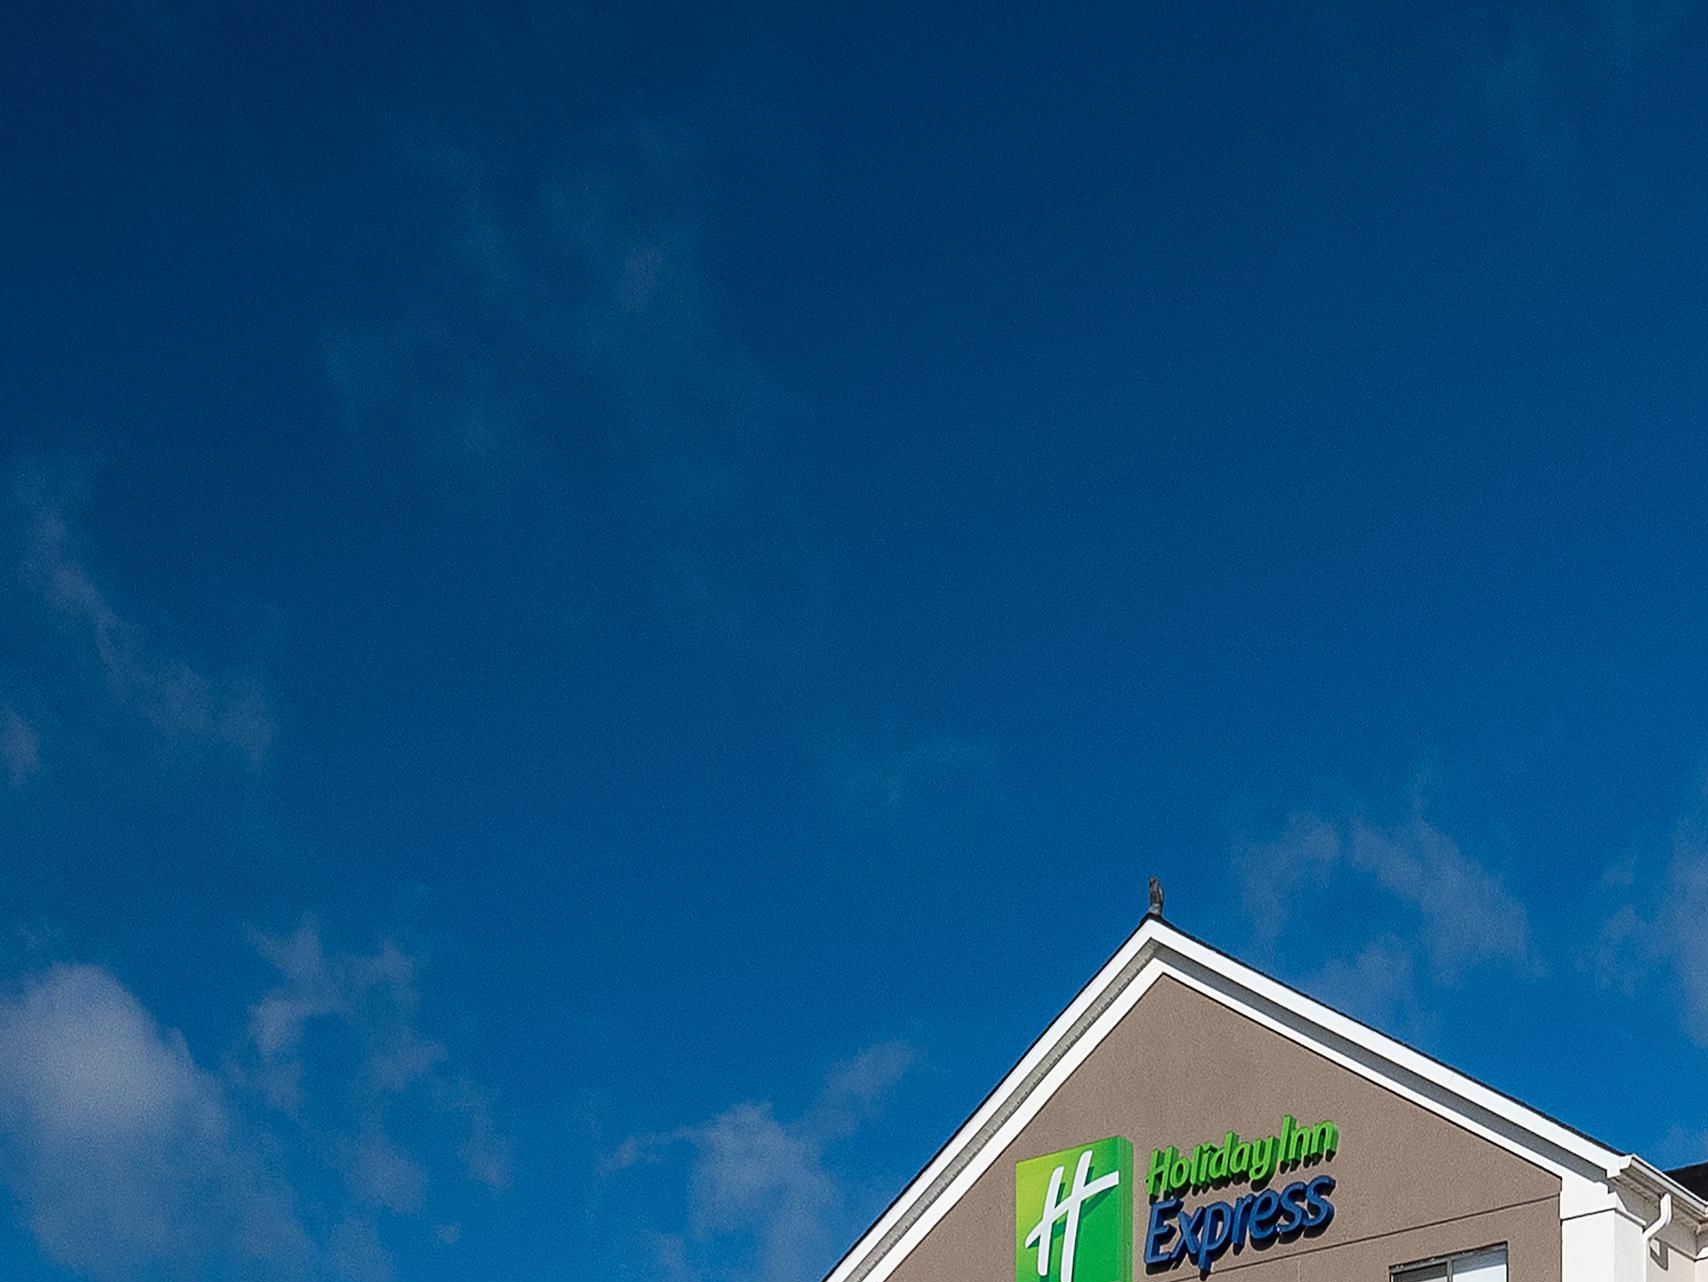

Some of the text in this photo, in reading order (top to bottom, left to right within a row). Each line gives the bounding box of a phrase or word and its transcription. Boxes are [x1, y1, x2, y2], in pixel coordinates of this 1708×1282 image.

[1146, 1114, 1339, 1197] Holiday Inn
[1143, 1175, 1337, 1275] Express
